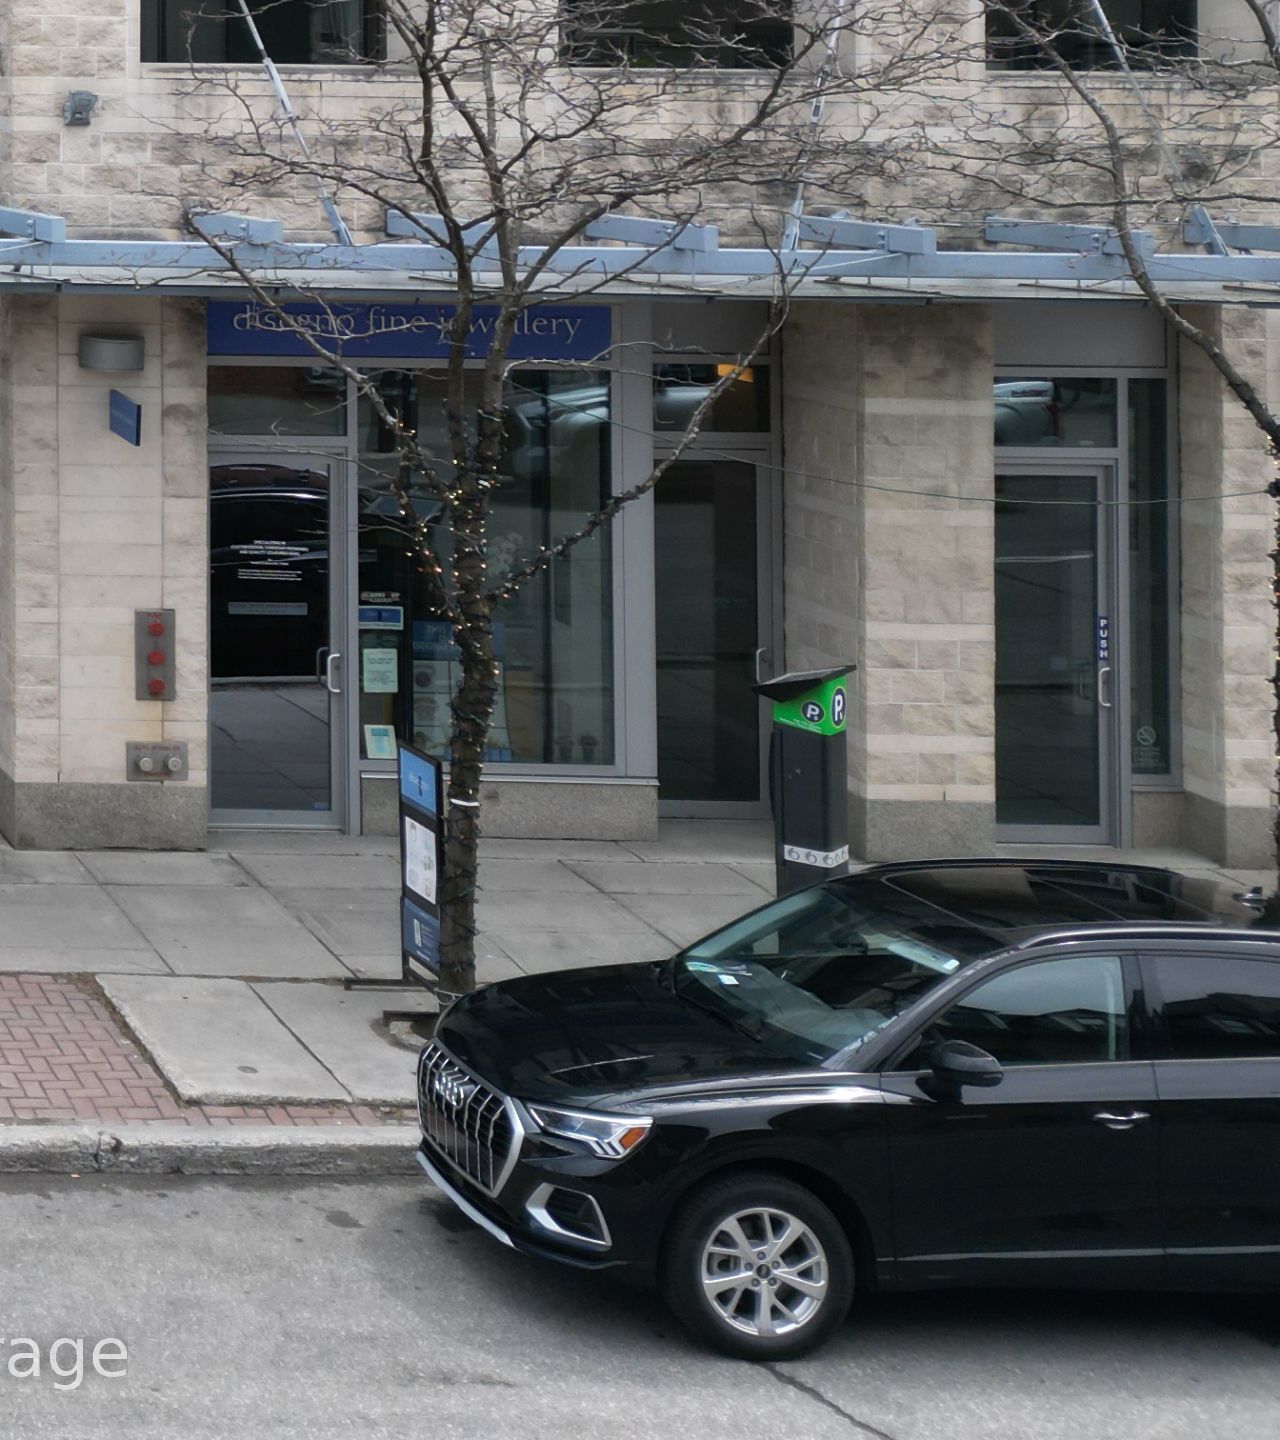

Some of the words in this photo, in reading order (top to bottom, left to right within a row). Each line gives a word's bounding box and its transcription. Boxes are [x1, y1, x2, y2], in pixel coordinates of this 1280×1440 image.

[369, 306, 426, 333] fine
[438, 309, 583, 344] jwllery
[1099, 619, 1109, 658] PUSH
